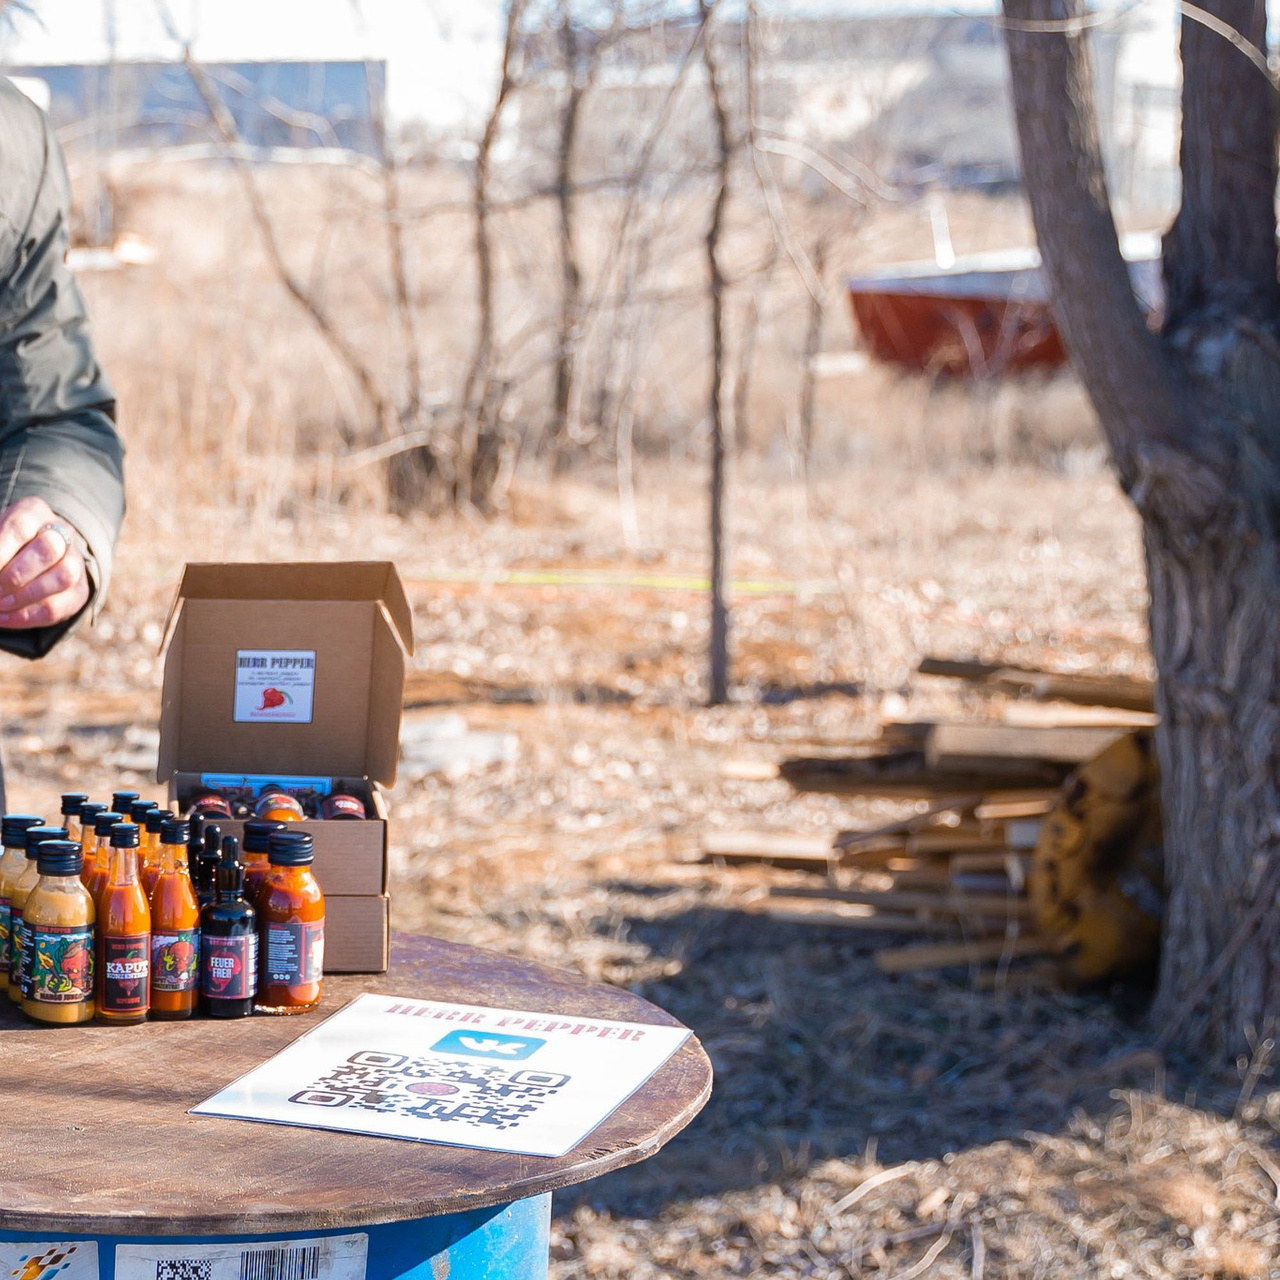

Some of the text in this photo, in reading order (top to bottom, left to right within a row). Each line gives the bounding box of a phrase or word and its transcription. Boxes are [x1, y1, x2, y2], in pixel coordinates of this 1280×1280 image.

[107, 960, 148, 974] KAPUT
[211, 957, 234, 968] FEUER
[385, 1003, 647, 1042] HERR PEPPER
